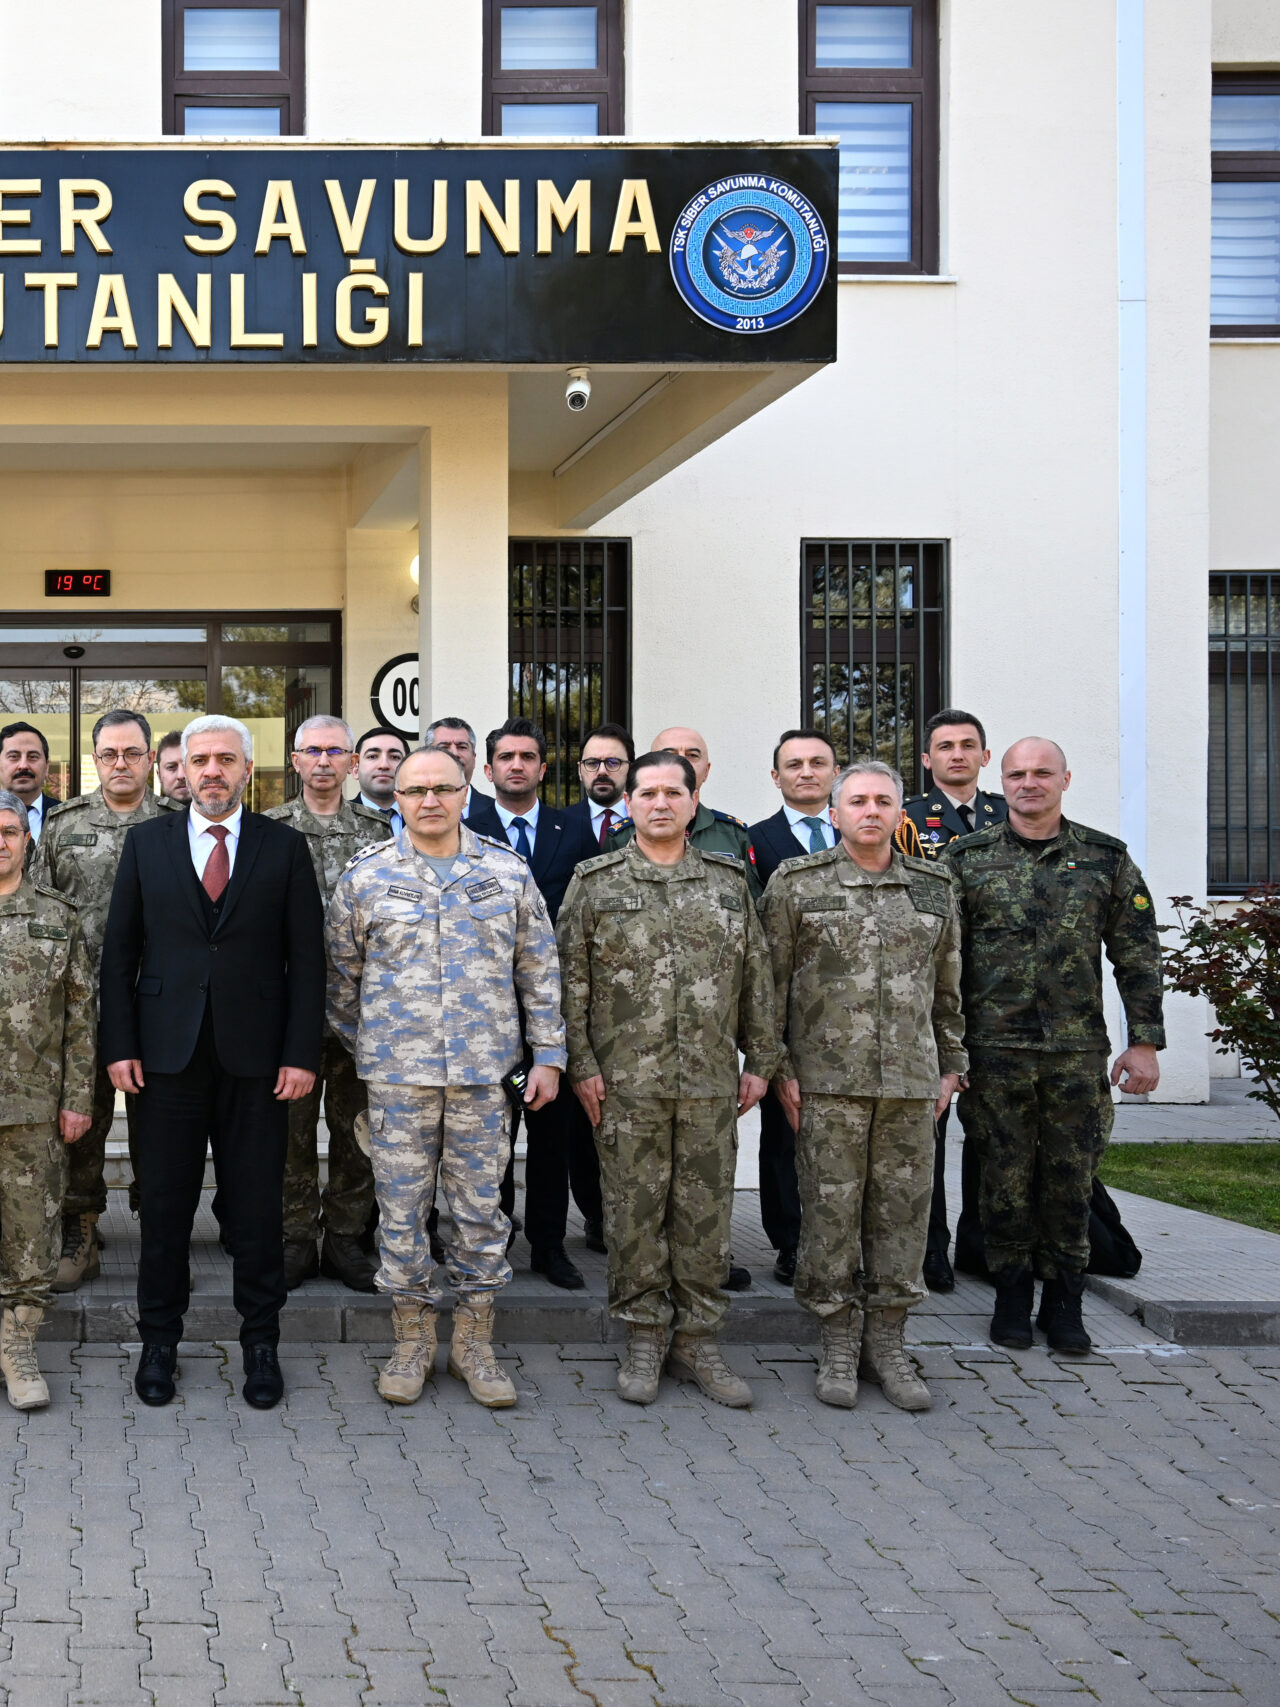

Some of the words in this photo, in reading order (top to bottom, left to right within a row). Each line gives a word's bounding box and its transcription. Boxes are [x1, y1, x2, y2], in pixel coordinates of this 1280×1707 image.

[183, 178, 662, 255] SAVUNMA
[673, 229, 688, 253] TSK
[681, 193, 710, 227] SİBER
[707, 176, 767, 199] SAVUNMA
[768, 180, 826, 253] KOMUTANLIĞI
[735, 317, 765, 330] 2013
[57, 575, 73, 590] 19
